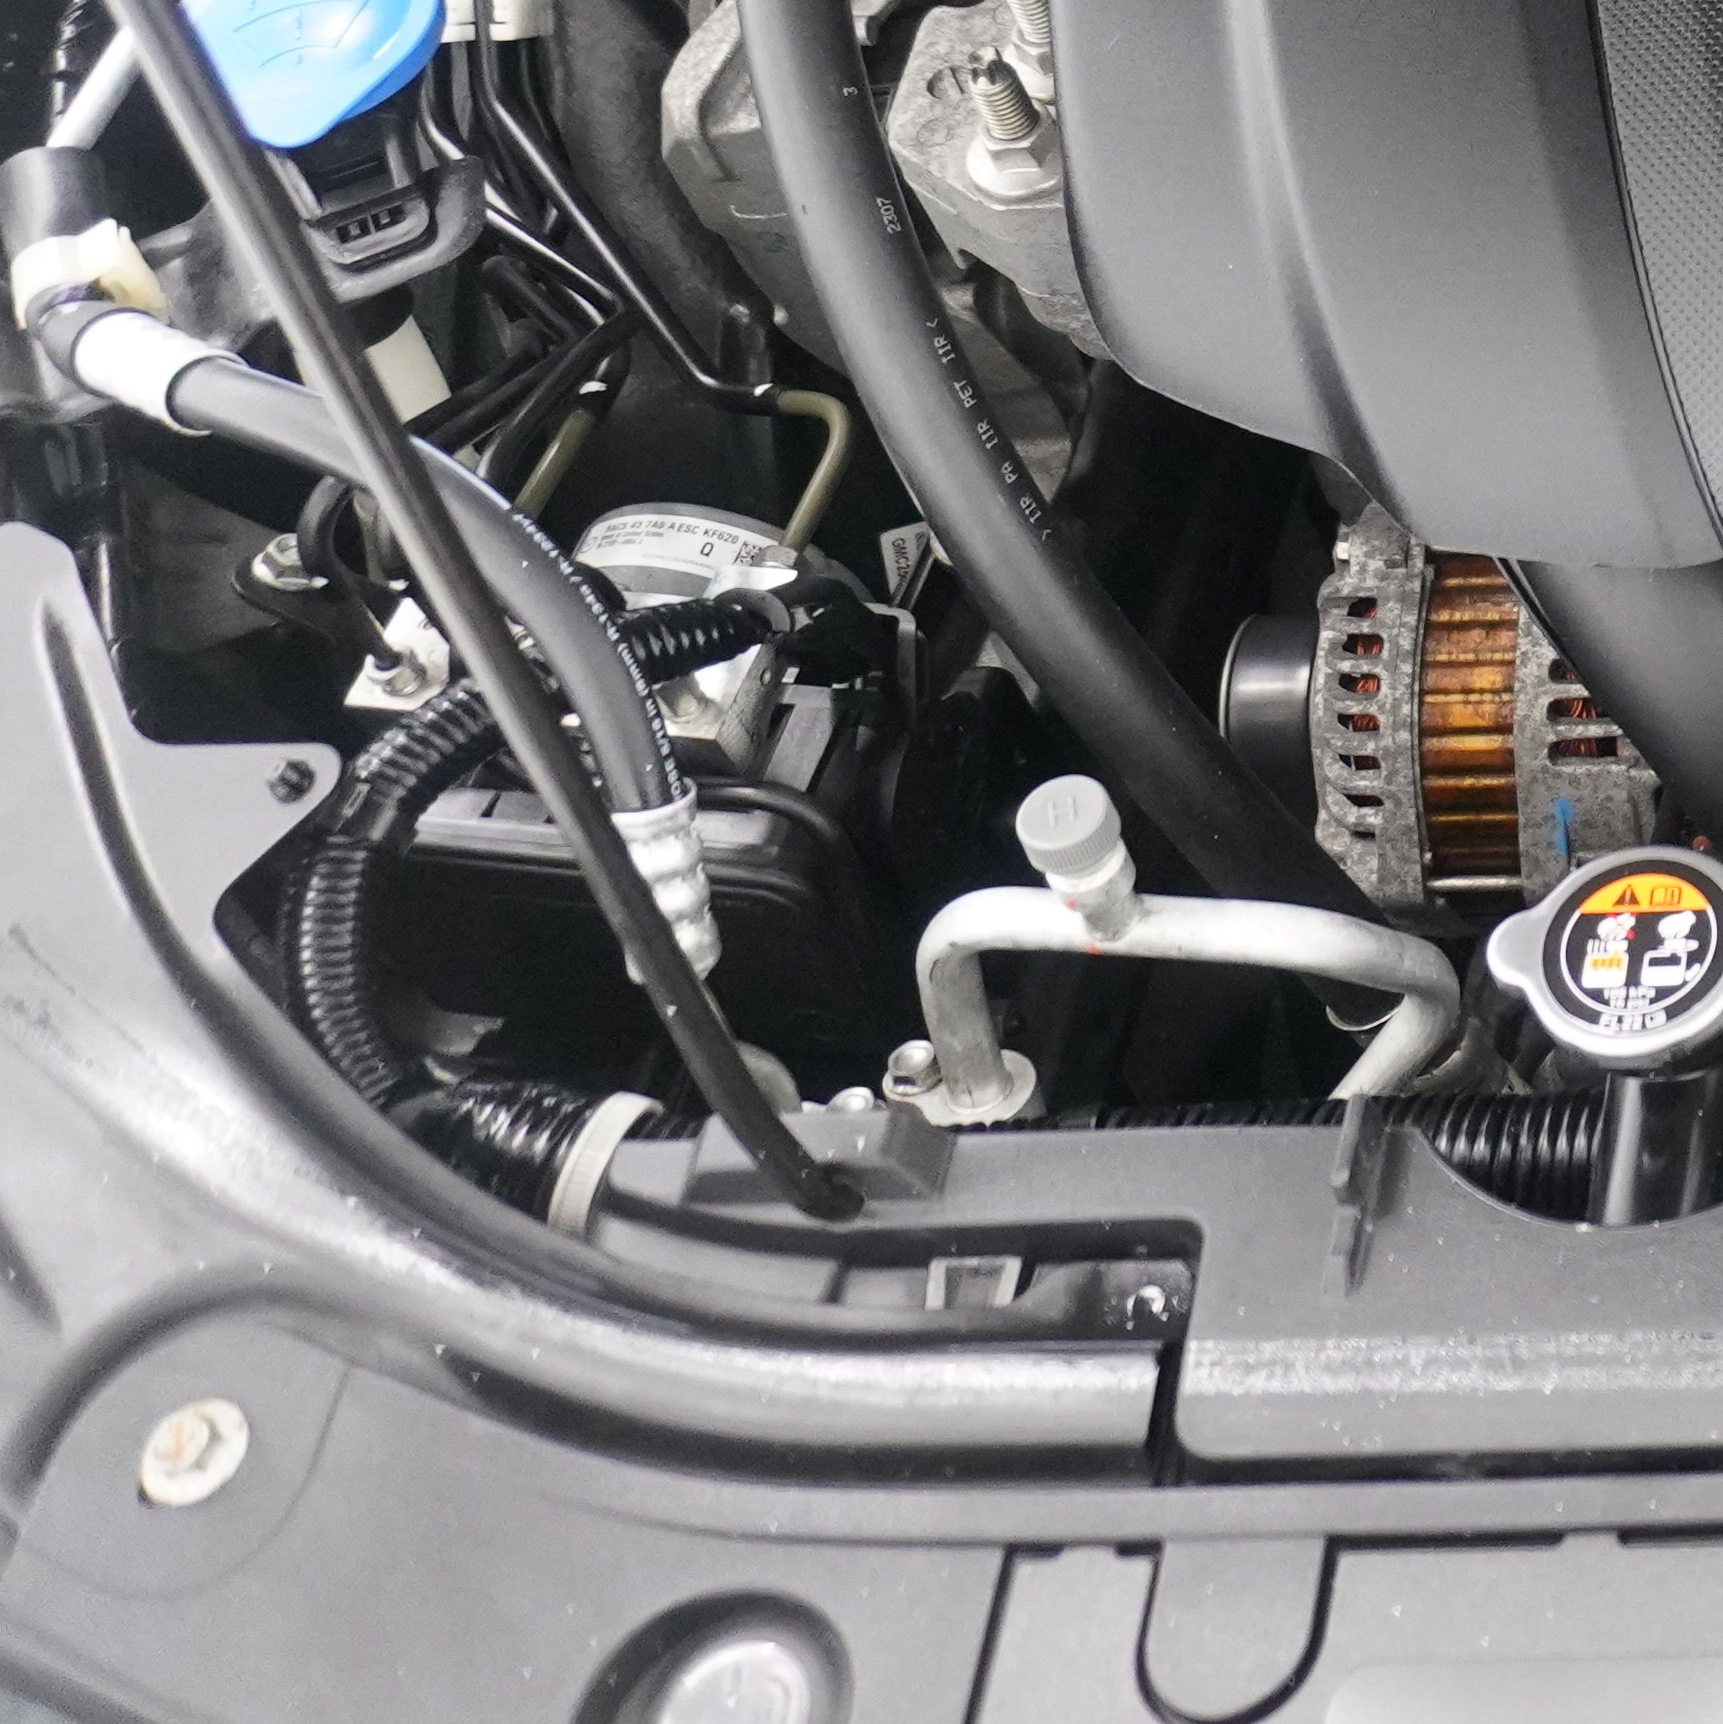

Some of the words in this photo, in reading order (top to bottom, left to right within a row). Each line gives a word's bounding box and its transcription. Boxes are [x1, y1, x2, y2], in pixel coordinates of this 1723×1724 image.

[876, 196, 901, 234] 2307
[952, 379, 978, 408] PET
[1001, 460, 1019, 484] PA
[677, 522, 701, 535] ESC
[1047, 795, 1079, 830] H
